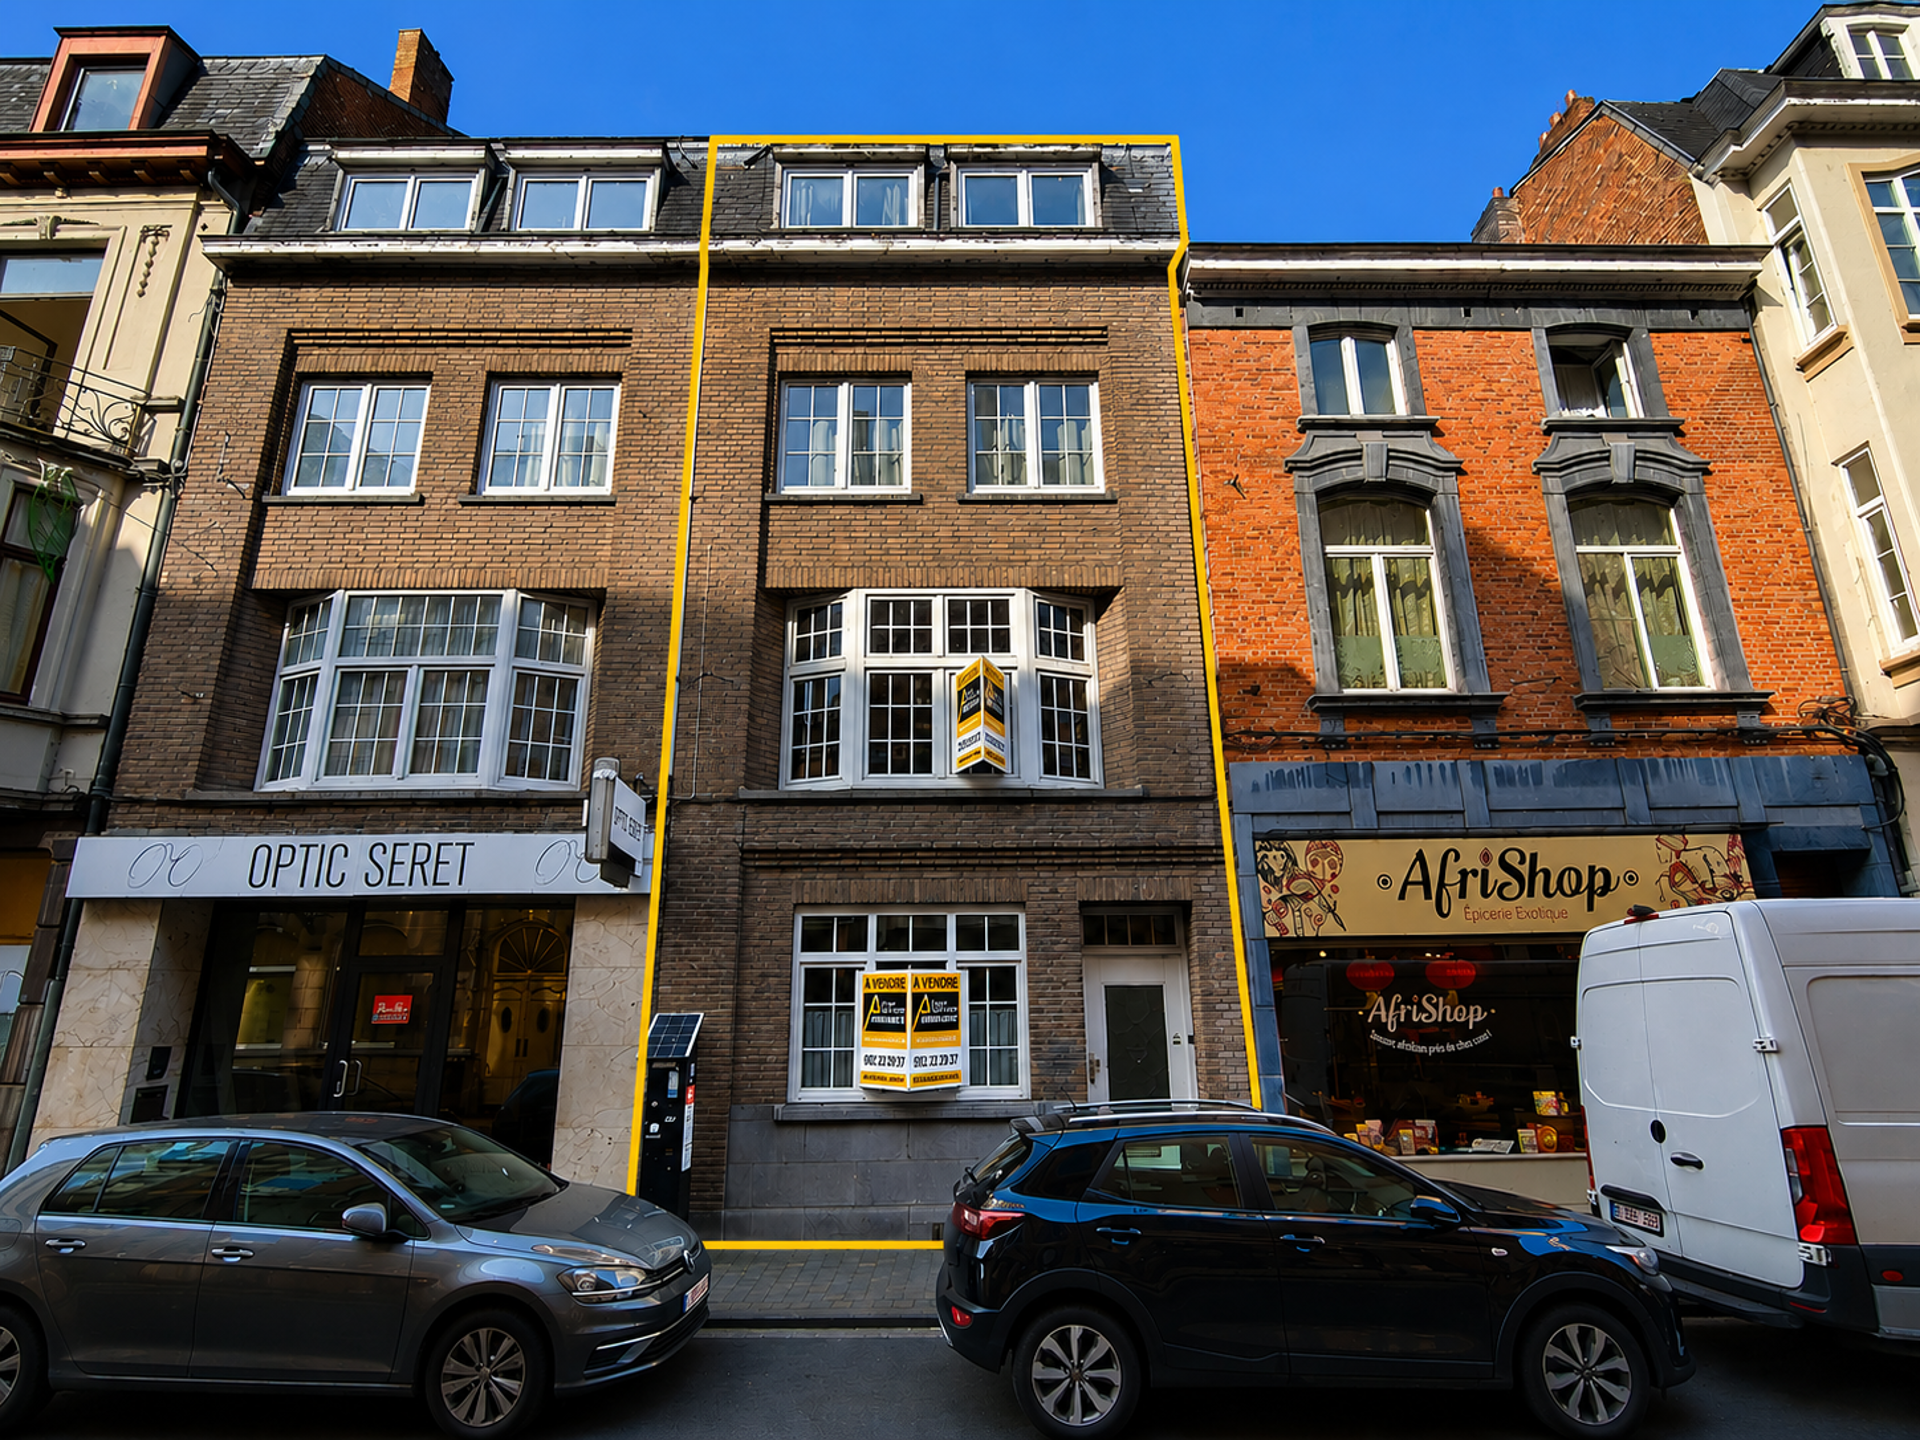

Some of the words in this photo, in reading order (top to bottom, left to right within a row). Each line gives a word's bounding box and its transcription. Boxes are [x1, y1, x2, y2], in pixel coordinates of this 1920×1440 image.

[248, 843, 349, 888] OPTIC
[364, 841, 475, 887] SERET
[1398, 847, 1620, 918] AfriShop
[1464, 903, 1513, 923] Épicerie
[1515, 905, 1569, 923] Exotique
[922, 976, 959, 989] VENDRE
[1367, 993, 1488, 1032] AfriShop
